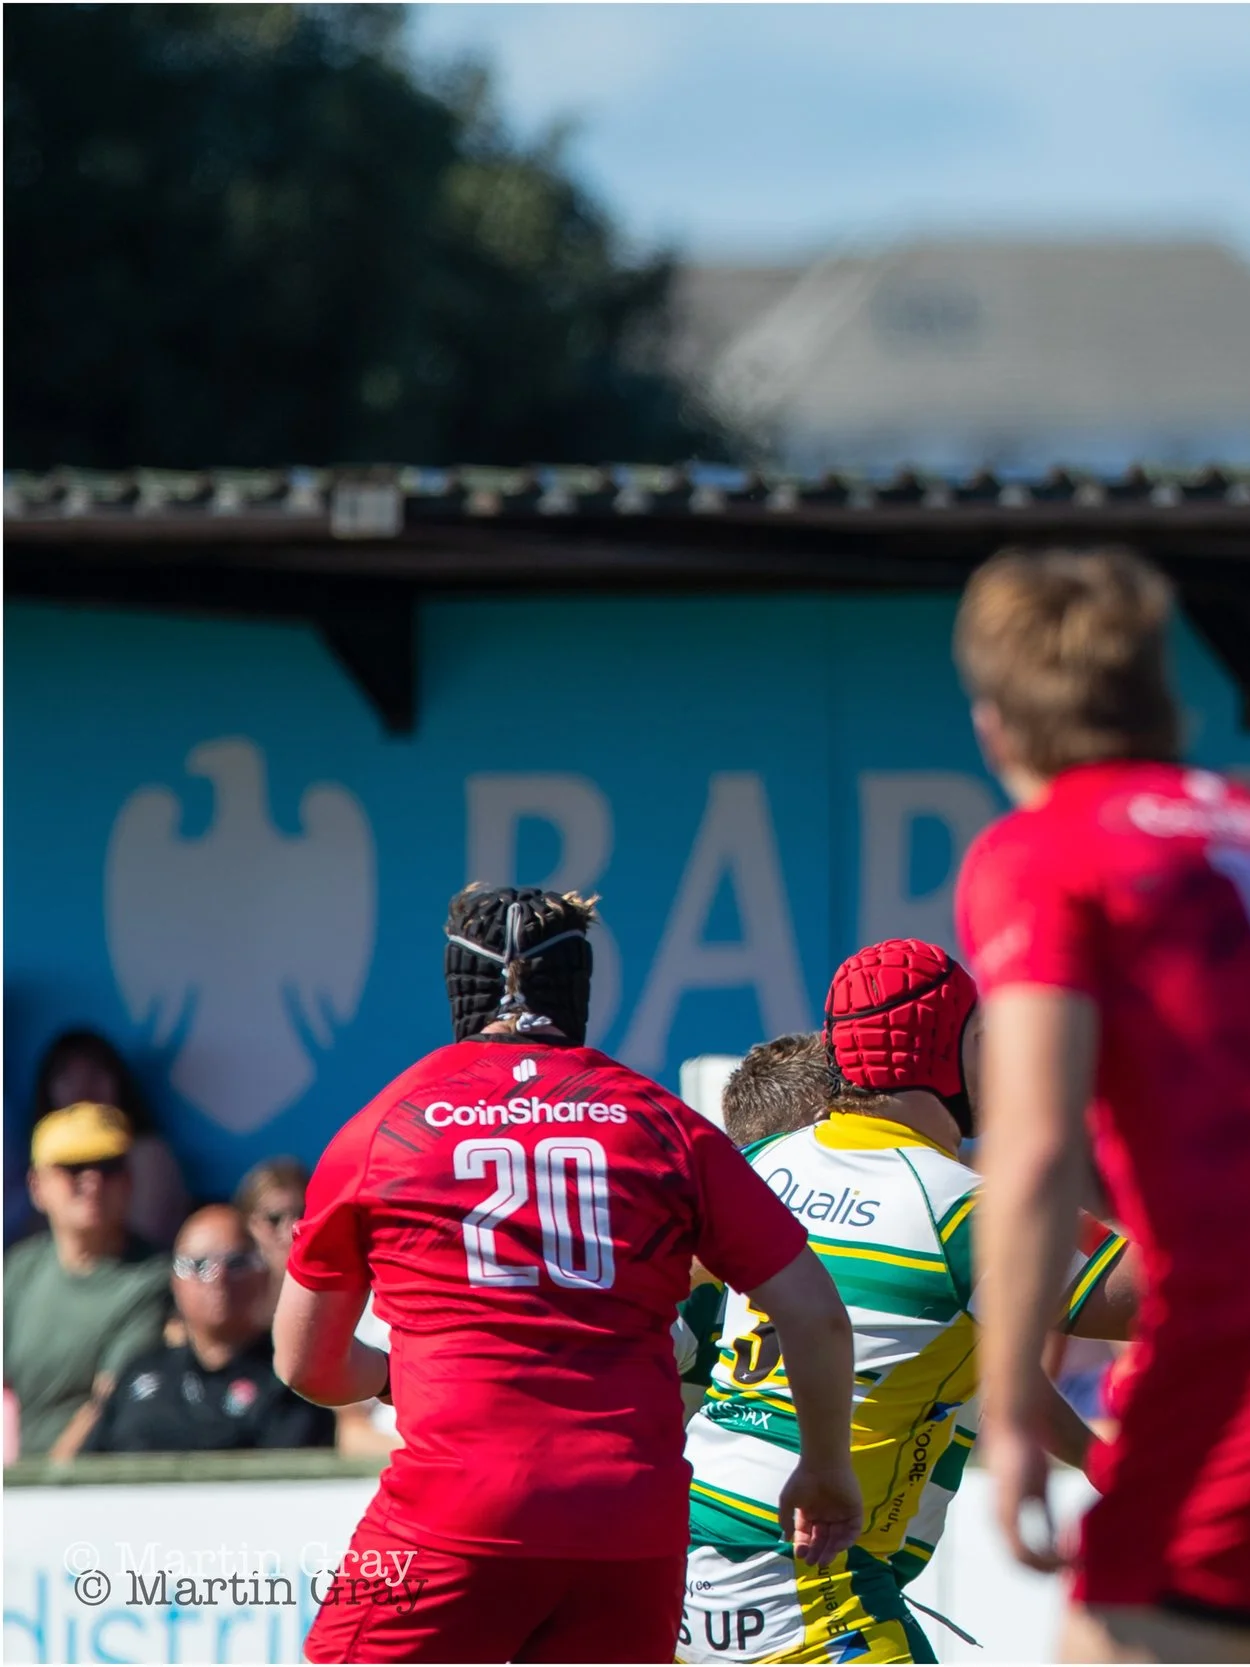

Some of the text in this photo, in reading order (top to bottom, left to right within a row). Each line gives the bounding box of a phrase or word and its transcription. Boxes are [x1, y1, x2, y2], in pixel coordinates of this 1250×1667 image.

[424, 1096, 628, 1127] CoinShares
[453, 1137, 616, 1289] 20
[764, 1168, 881, 1227] Qualis
[705, 1608, 765, 1651] UP
